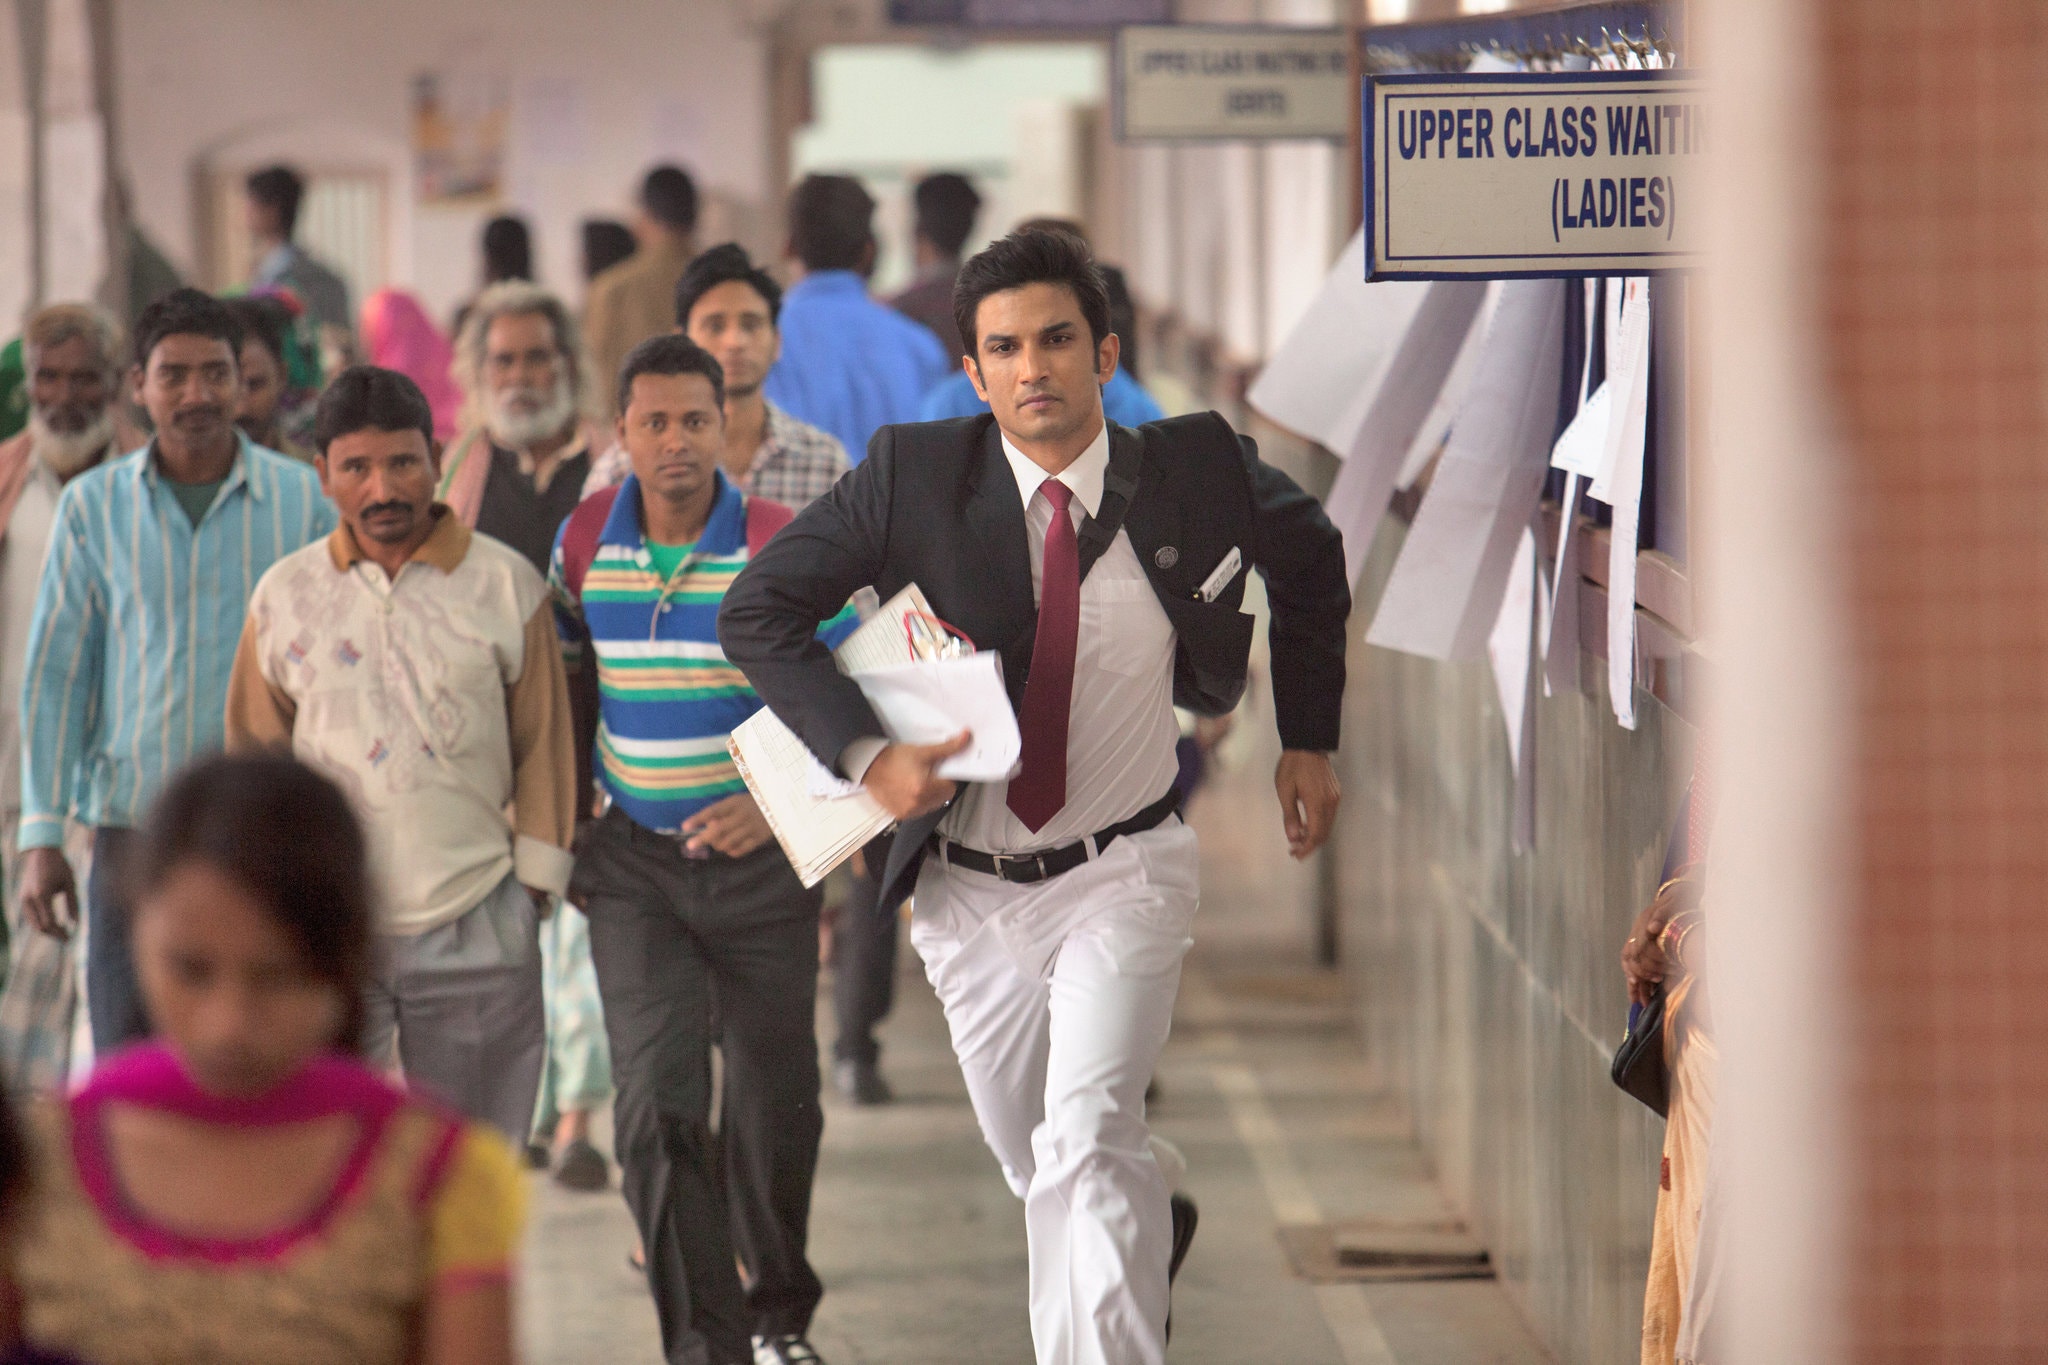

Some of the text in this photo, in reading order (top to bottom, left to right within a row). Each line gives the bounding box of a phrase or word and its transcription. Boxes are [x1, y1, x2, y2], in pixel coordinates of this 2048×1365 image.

[1398, 108, 1494, 160] UPPER
[1504, 106, 1597, 158] CLASS
[1551, 175, 1675, 243] (LADIES)
